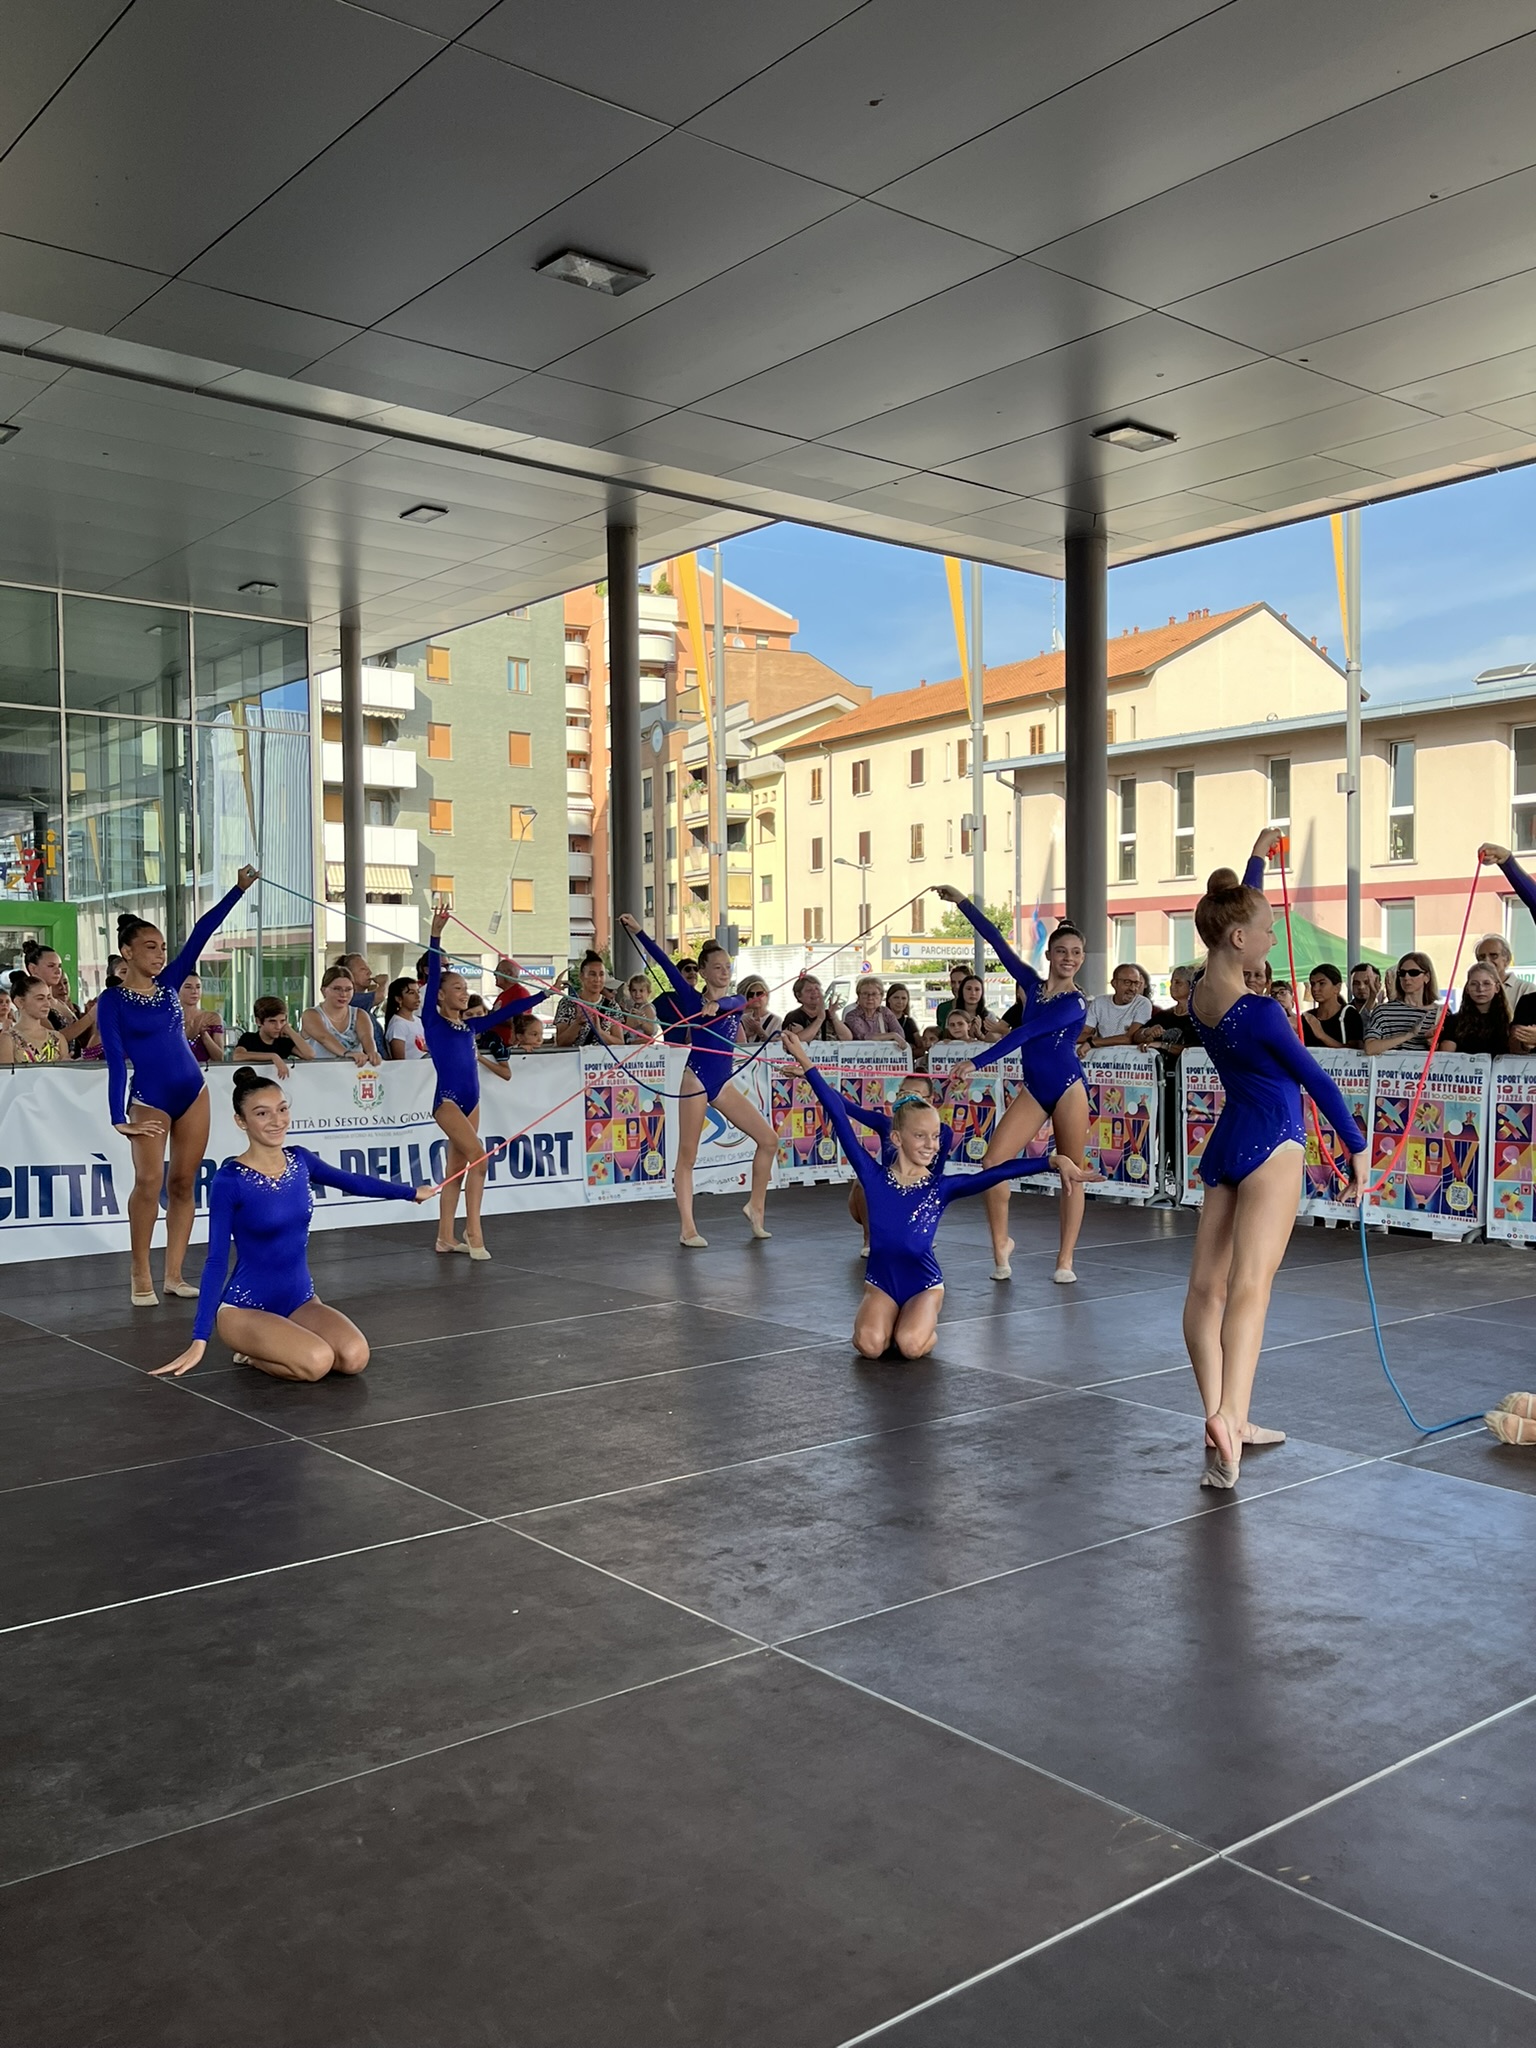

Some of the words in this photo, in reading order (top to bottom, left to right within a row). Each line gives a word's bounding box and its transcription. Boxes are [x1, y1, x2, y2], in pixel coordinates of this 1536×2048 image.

[921, 946, 969, 956] PARCHEGGIO
[1116, 1071, 1153, 1080] SETTEMBRE
[1344, 1068, 1369, 1078] SALUTE
[1378, 1070, 1398, 1079] SPORT
[1455, 1075, 1483, 1084] SALUTE
[1497, 1075, 1522, 1084] SPORT
[1376, 1088, 1400, 1096] PIAZZA
[1404, 1082, 1426, 1090] 20
[1432, 1083, 1482, 1094] SETTEMBRE
[288, 1117, 316, 1130] ITTÀ
[318, 1118, 331, 1128] DI
[334, 1116, 368, 1128] SESTO
[372, 1115, 396, 1125] SAN
[400, 1112, 433, 1123] GIOVA
[479, 1132, 574, 1181] PORT
